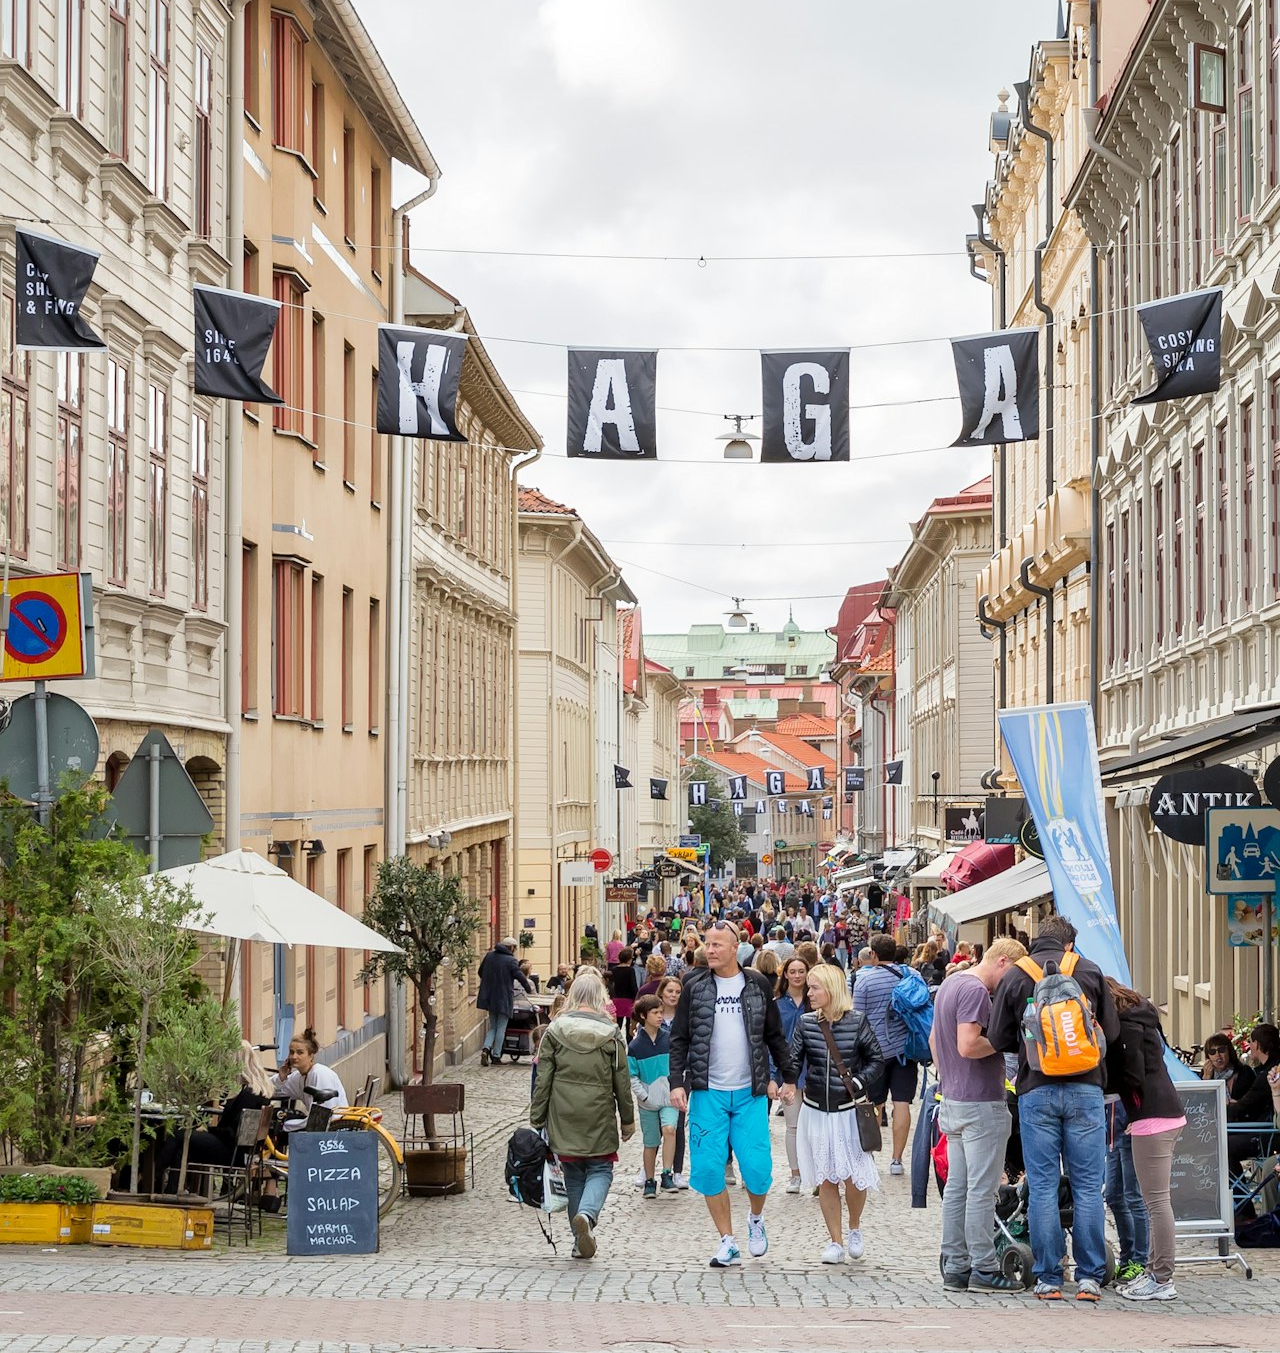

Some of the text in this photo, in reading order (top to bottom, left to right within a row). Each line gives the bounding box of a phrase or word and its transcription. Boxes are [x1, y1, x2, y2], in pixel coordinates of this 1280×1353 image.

[26, 300, 36, 314] &
[1158, 330, 1193, 349] COSY
[319, 1140, 344, 1151] 8586
[308, 1167, 361, 1182] PIZZA
[307, 1197, 359, 1211] SALLAD
[307, 1224, 348, 1234] VARMA
[310, 1235, 356, 1245] MACKOR
